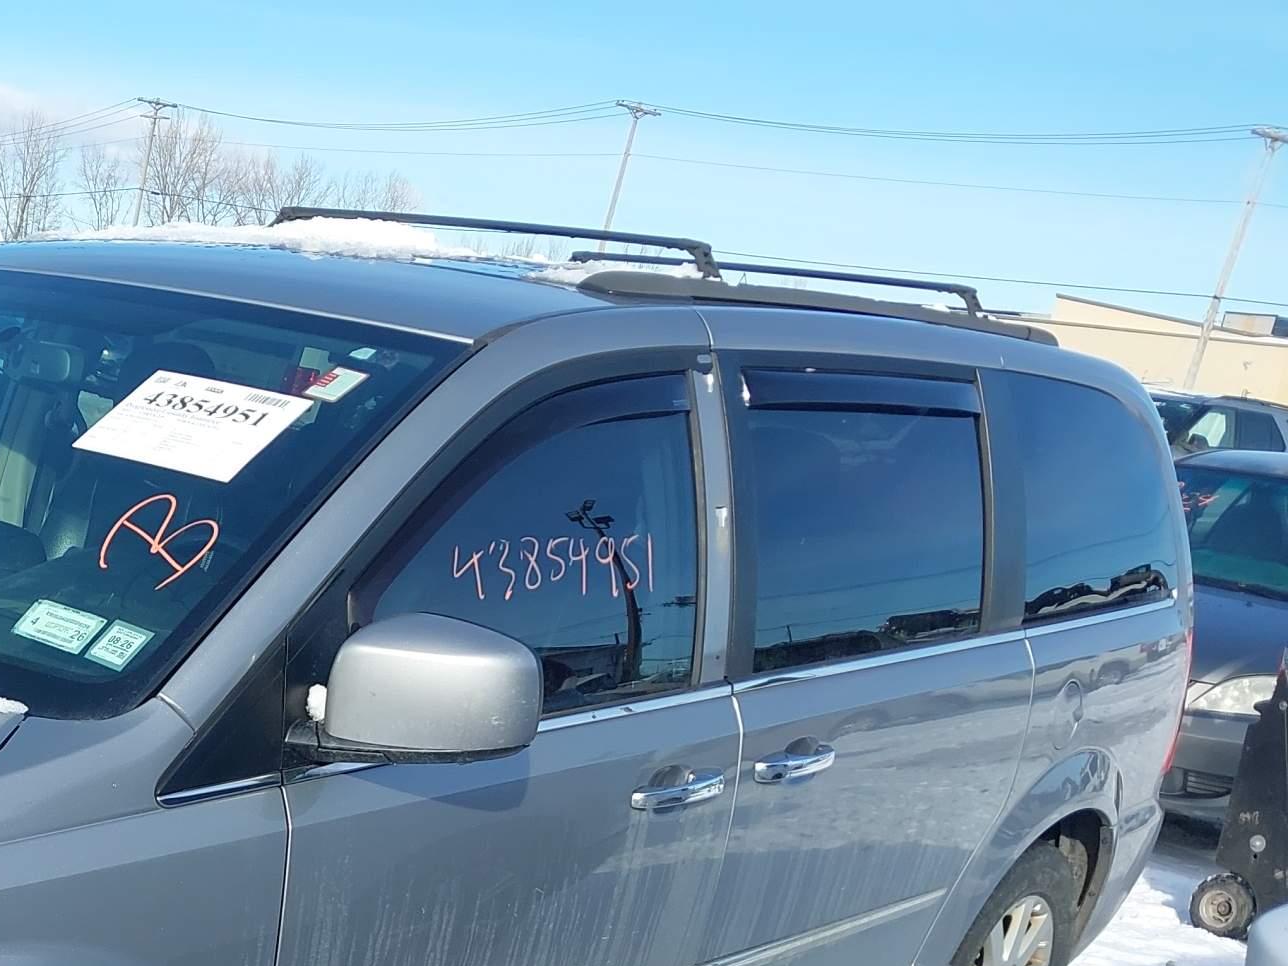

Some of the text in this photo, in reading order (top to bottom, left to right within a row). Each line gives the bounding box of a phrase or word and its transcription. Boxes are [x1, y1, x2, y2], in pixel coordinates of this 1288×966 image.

[143, 391, 269, 427] 43854951
[452, 532, 654, 601] 43854951
[69, 629, 88, 642] 26
